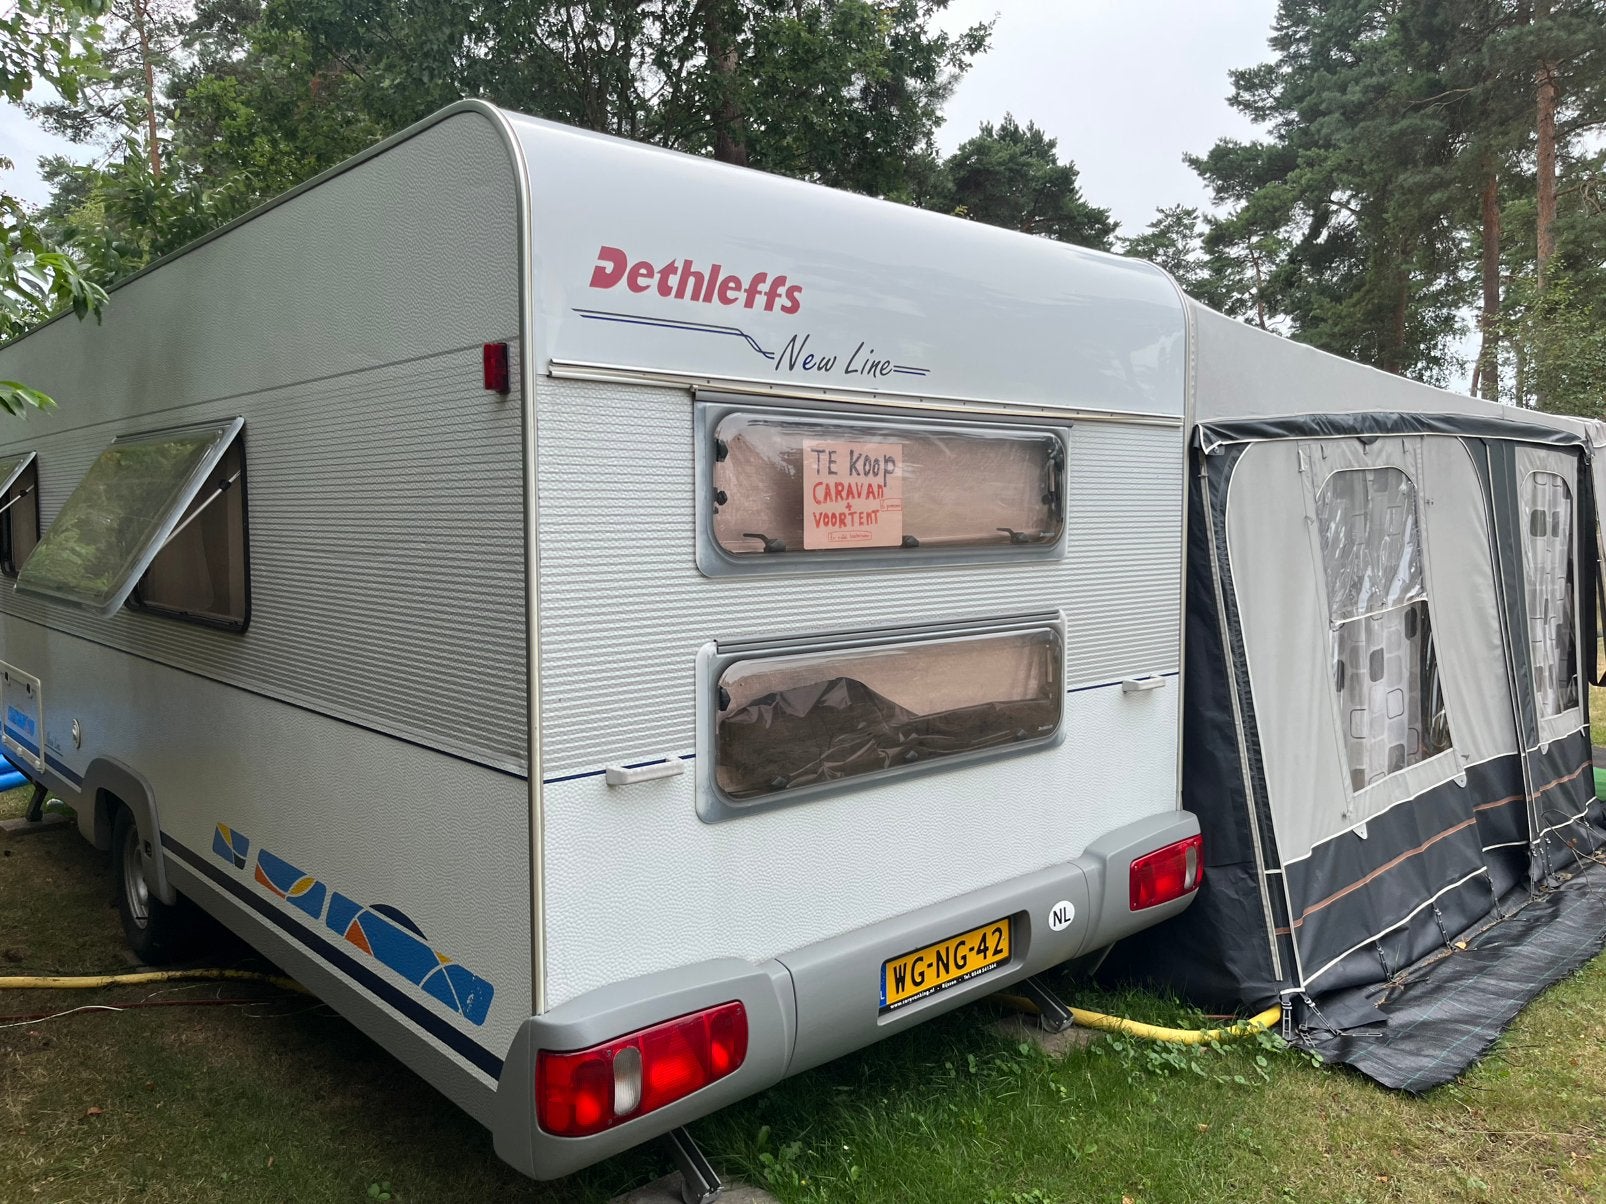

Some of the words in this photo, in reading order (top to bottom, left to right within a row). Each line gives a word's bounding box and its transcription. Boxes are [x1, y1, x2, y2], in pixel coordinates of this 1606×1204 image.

[589, 245, 803, 315] Dethleffs
[775, 333, 838, 372] New
[844, 341, 894, 378] Line
[810, 448, 838, 475] TE
[845, 502, 852, 511] +
[1053, 906, 1071, 927] NL
[893, 926, 1004, 995] WG-NG-42
